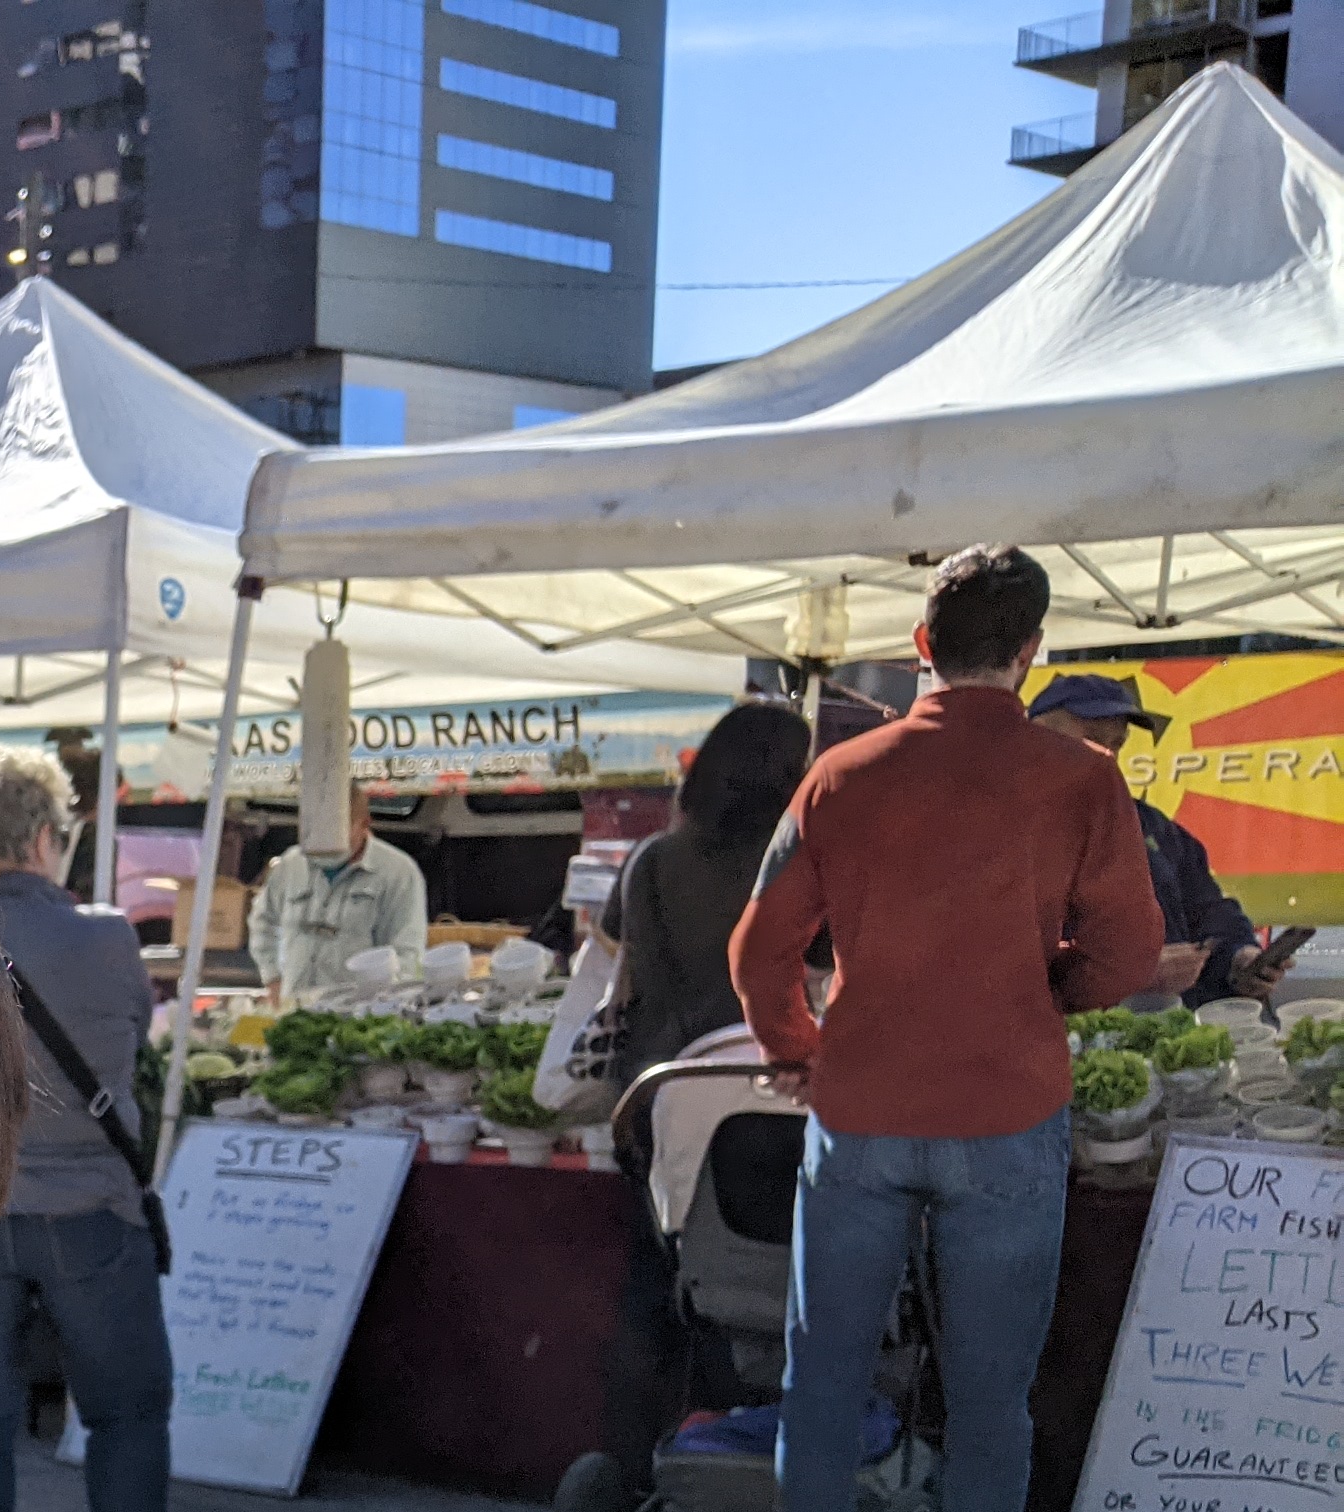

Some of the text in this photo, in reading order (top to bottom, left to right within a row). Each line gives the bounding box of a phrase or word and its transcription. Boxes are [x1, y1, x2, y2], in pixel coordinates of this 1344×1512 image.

[431, 704, 580, 749] RANCH
[215, 1134, 346, 1173] STEPS
[1183, 1156, 1283, 1208] OUR
[1168, 1201, 1259, 1234] FARM
[1224, 1297, 1321, 1342] LASTS
[1140, 1326, 1344, 1389] THREE WE
[1104, 1490, 1137, 1511] OR
